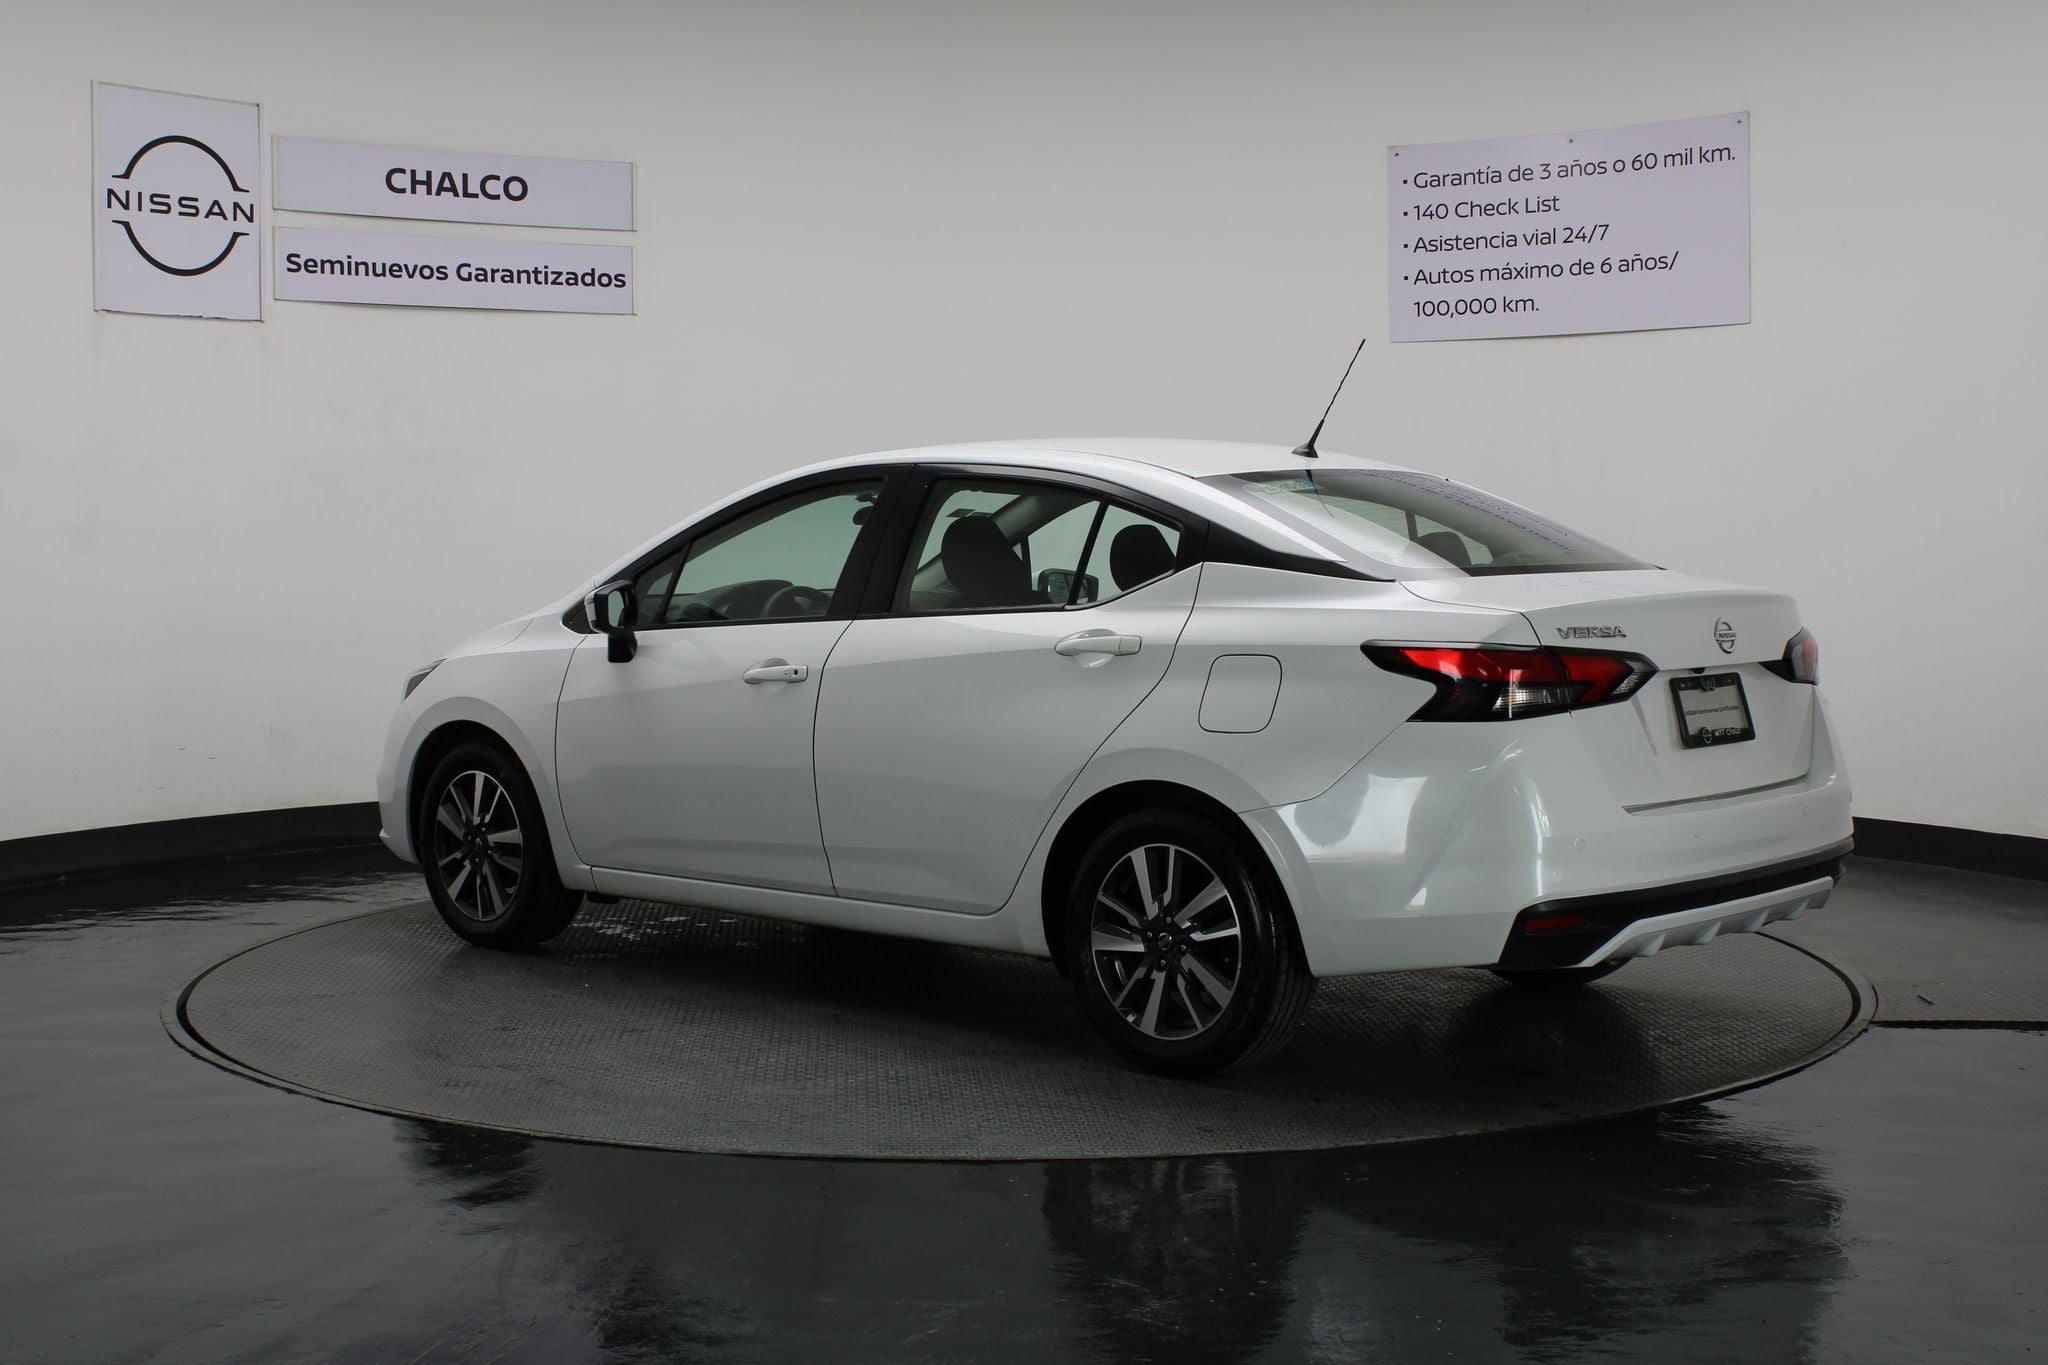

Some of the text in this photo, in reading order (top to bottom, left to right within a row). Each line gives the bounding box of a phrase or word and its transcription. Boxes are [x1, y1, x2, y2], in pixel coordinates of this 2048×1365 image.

[385, 167, 529, 202] CHALCO
[1413, 145, 1737, 189] Garantía de 3 años o 60 mil km.
[106, 187, 255, 224] NISSAN
[1412, 195, 1561, 222] 140 Check List
[1412, 223, 1610, 254] Asistencia vial 24/7
[286, 252, 627, 289] Seminuevos Garantizados
[1413, 250, 1680, 286] Autos máximo de 6 años/
[1412, 295, 1540, 319] 100,000 km.
[1556, 625, 1627, 640] VERSA
